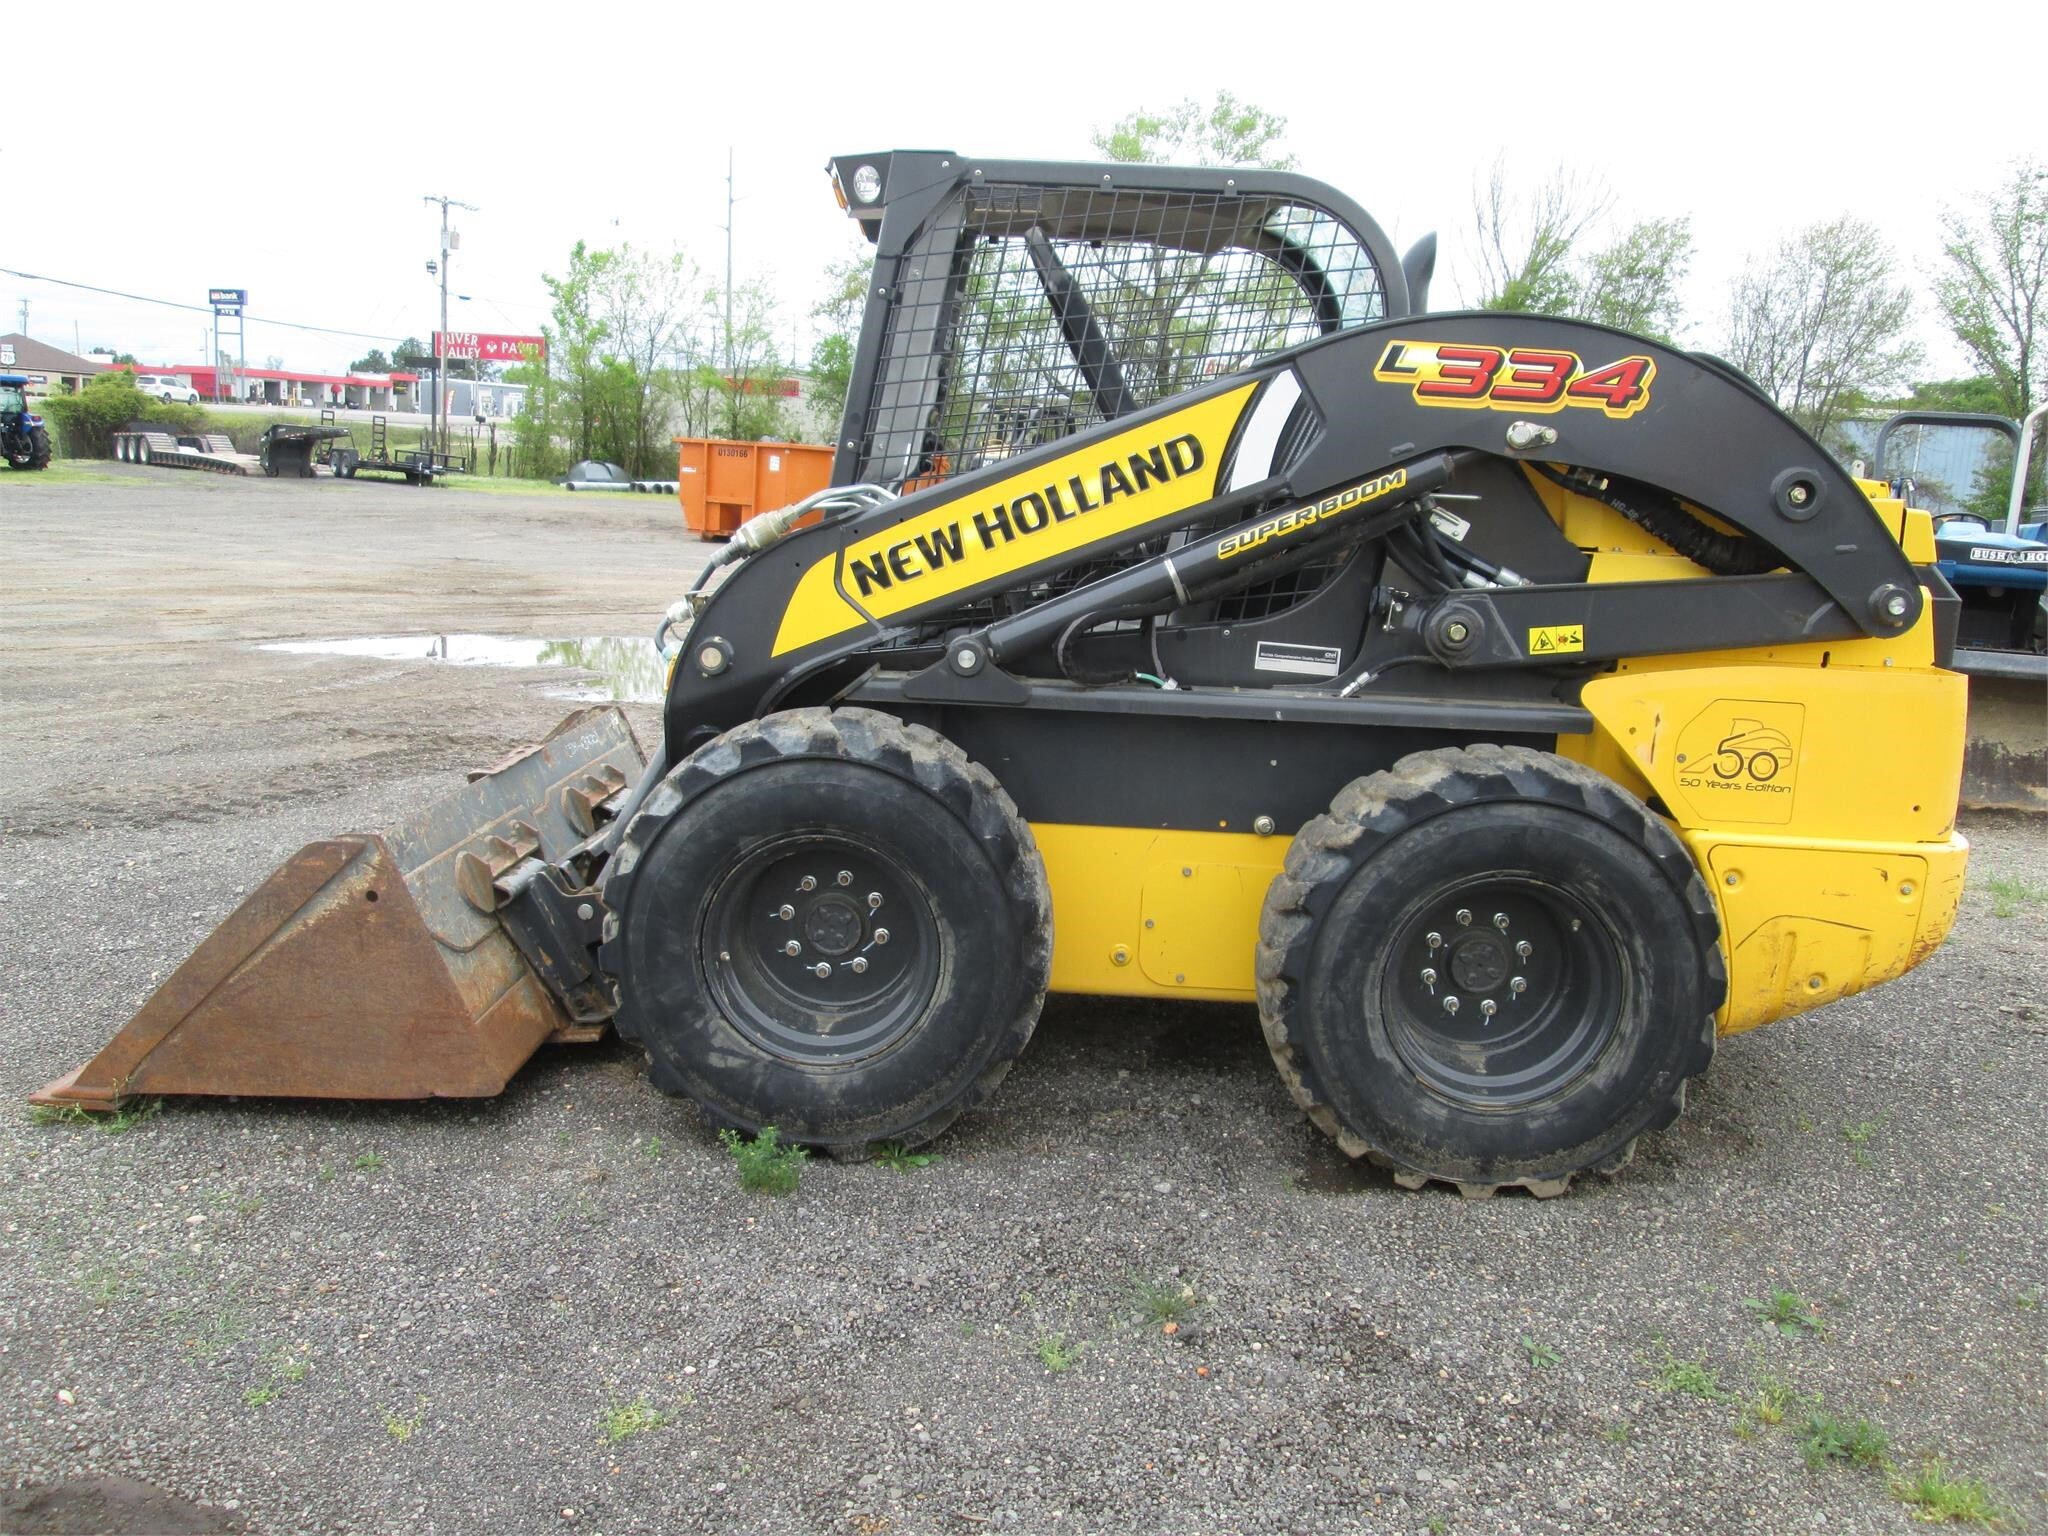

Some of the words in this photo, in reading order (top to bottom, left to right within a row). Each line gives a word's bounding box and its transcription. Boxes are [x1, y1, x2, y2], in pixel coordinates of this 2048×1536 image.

[1376, 342, 1654, 413] L334
[850, 520, 966, 598] NEW
[972, 433, 1205, 551] HOLLAND
[1219, 505, 1317, 559] SUPER
[1318, 468, 1408, 518] BOOM
[1973, 549, 2006, 560] BUSH
[2026, 552, 2048, 562] HO
[1680, 777, 1701, 788] 50
[1705, 779, 1742, 791] Years
[1745, 782, 1792, 793] Edition
[1713, 733, 1779, 782] 50
